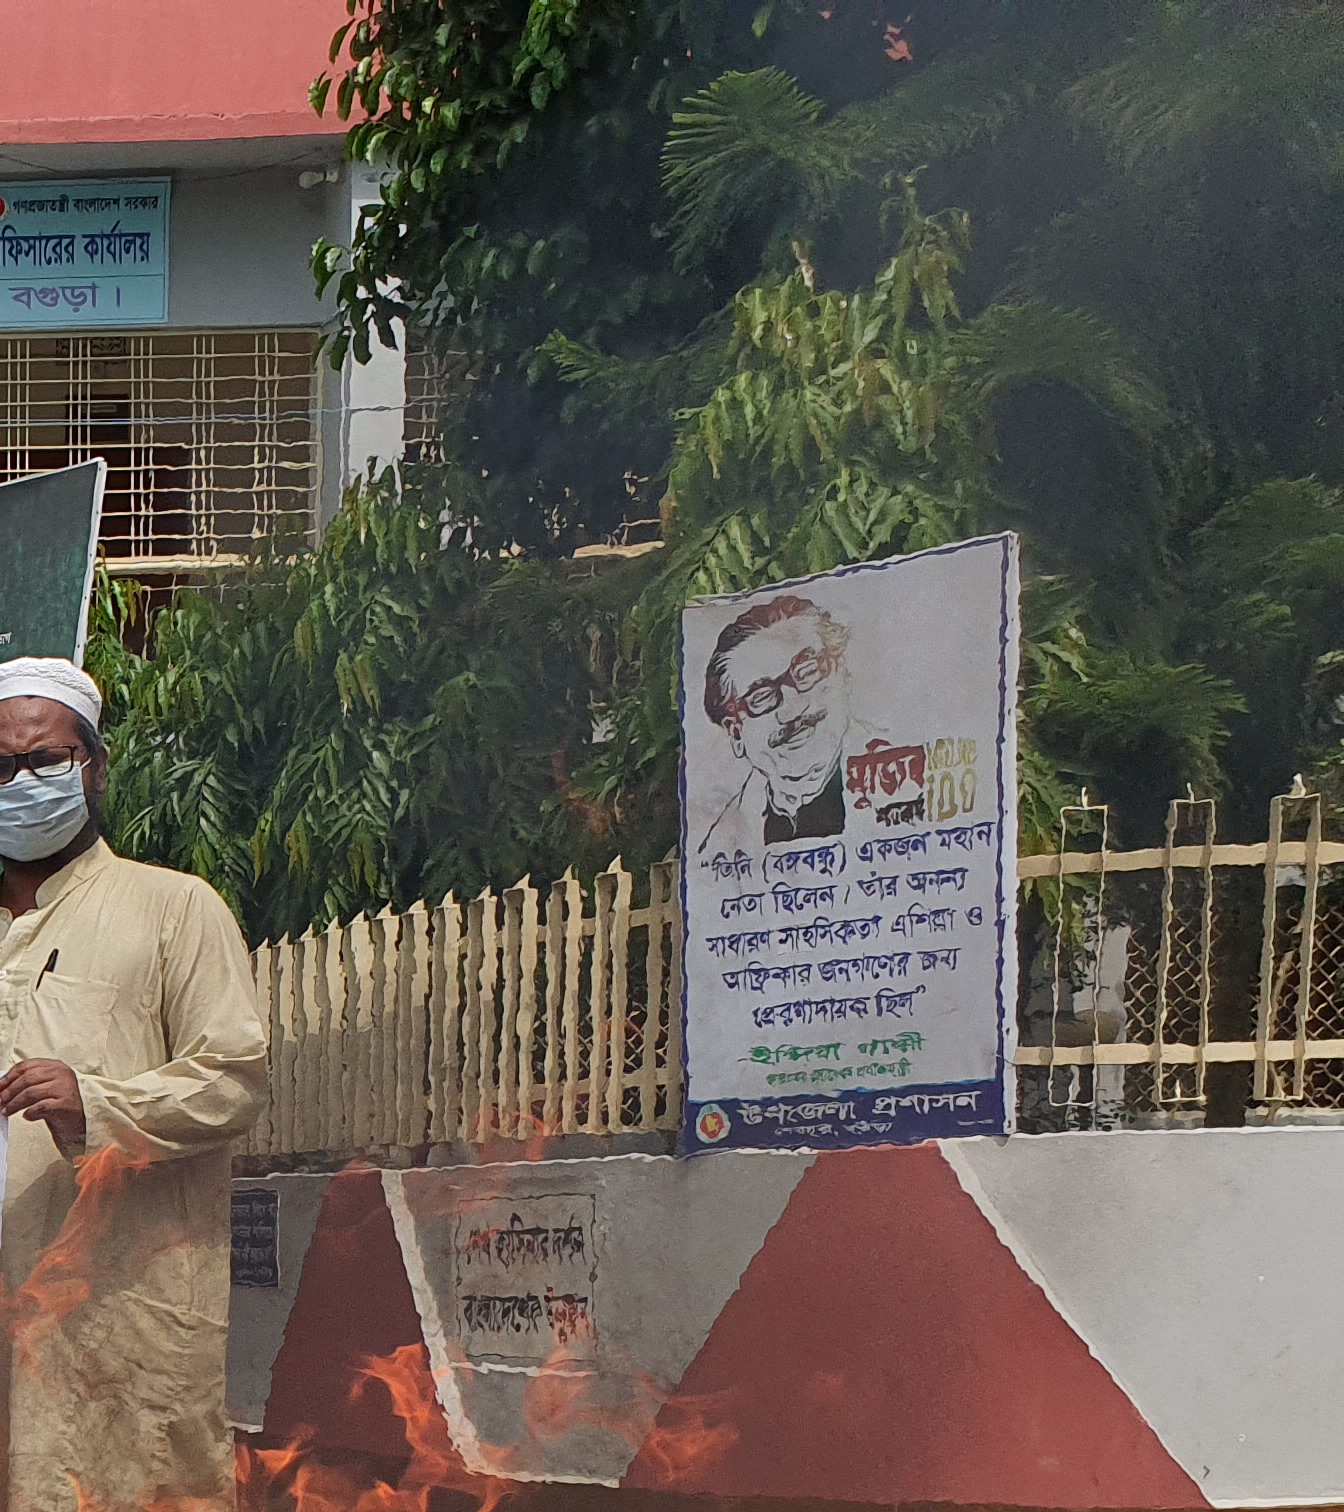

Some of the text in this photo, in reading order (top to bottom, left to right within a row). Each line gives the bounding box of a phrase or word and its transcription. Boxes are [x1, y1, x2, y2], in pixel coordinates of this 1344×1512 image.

[72, 197, 121, 213] বাংলাদেশ
[83, 220, 150, 264] কার্যালয়
[9, 283, 100, 313] বগুড়া
[856, 831, 930, 863] একজন
[934, 821, 995, 851] মহান
[720, 892, 766, 919] নেতা
[965, 906, 983, 926] ও
[917, 948, 962, 972] জন্য
[871, 1091, 982, 1117] প্রশাসন
